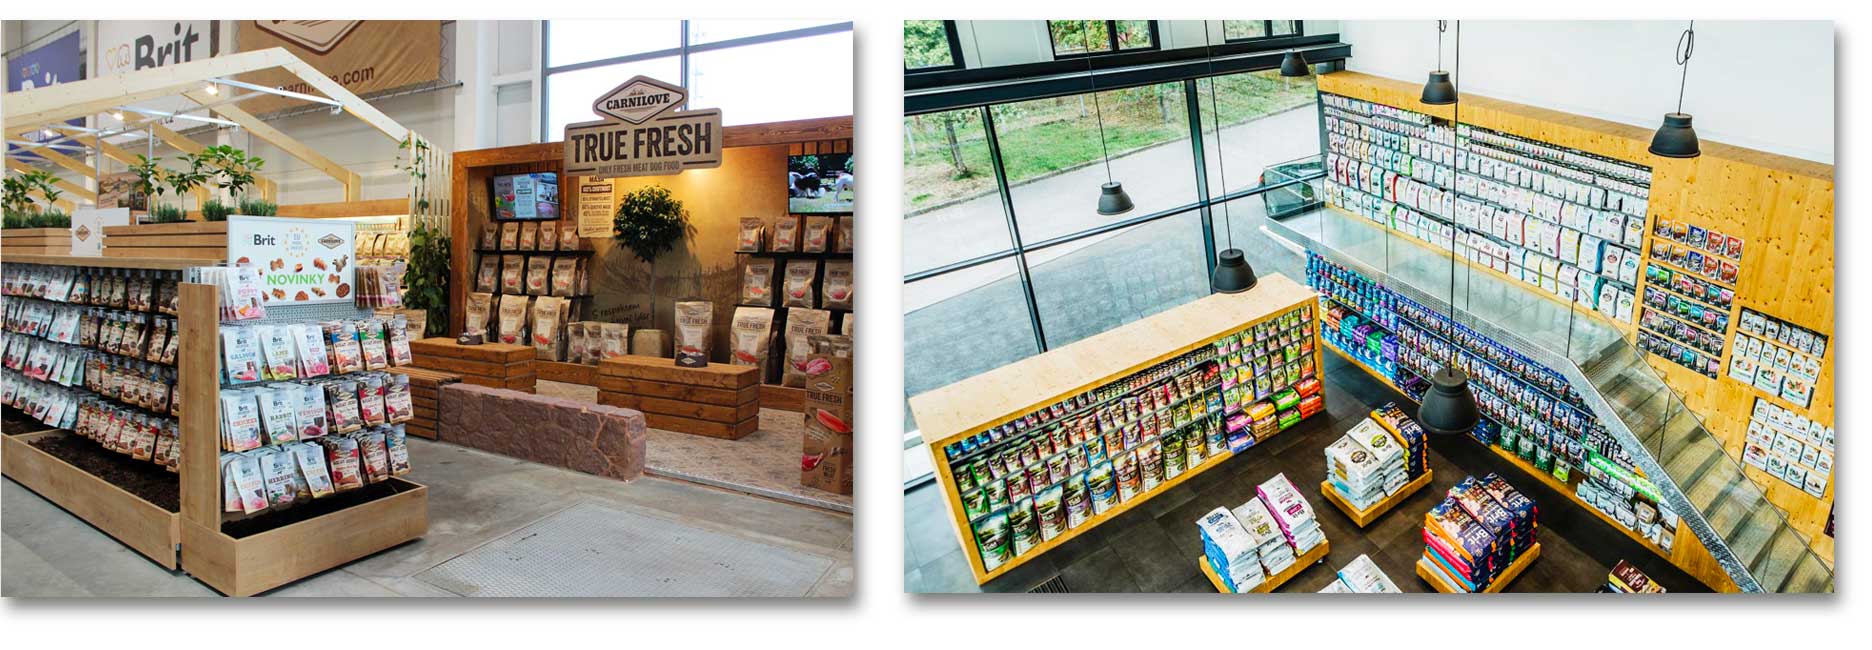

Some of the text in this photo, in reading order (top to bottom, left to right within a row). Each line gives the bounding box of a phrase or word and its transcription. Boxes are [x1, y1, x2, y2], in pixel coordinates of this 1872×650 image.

[135, 22, 199, 71] Brit
[606, 93, 671, 110] CARNILOVE
[571, 122, 712, 163] TRUE FRESH
[613, 164, 632, 173] FRESH
[633, 163, 648, 172] MEAT
[650, 162, 663, 171] DOG
[664, 160, 680, 170] FOOD
[253, 234, 276, 246] Brit
[267, 273, 325, 286] NOVINKY
[807, 391, 842, 403] TRUE FRESH
[1402, 424, 1422, 435] Brit
[1511, 495, 1531, 508] Brit
[1486, 508, 1508, 524] Brit
[1467, 528, 1489, 546] Brit
